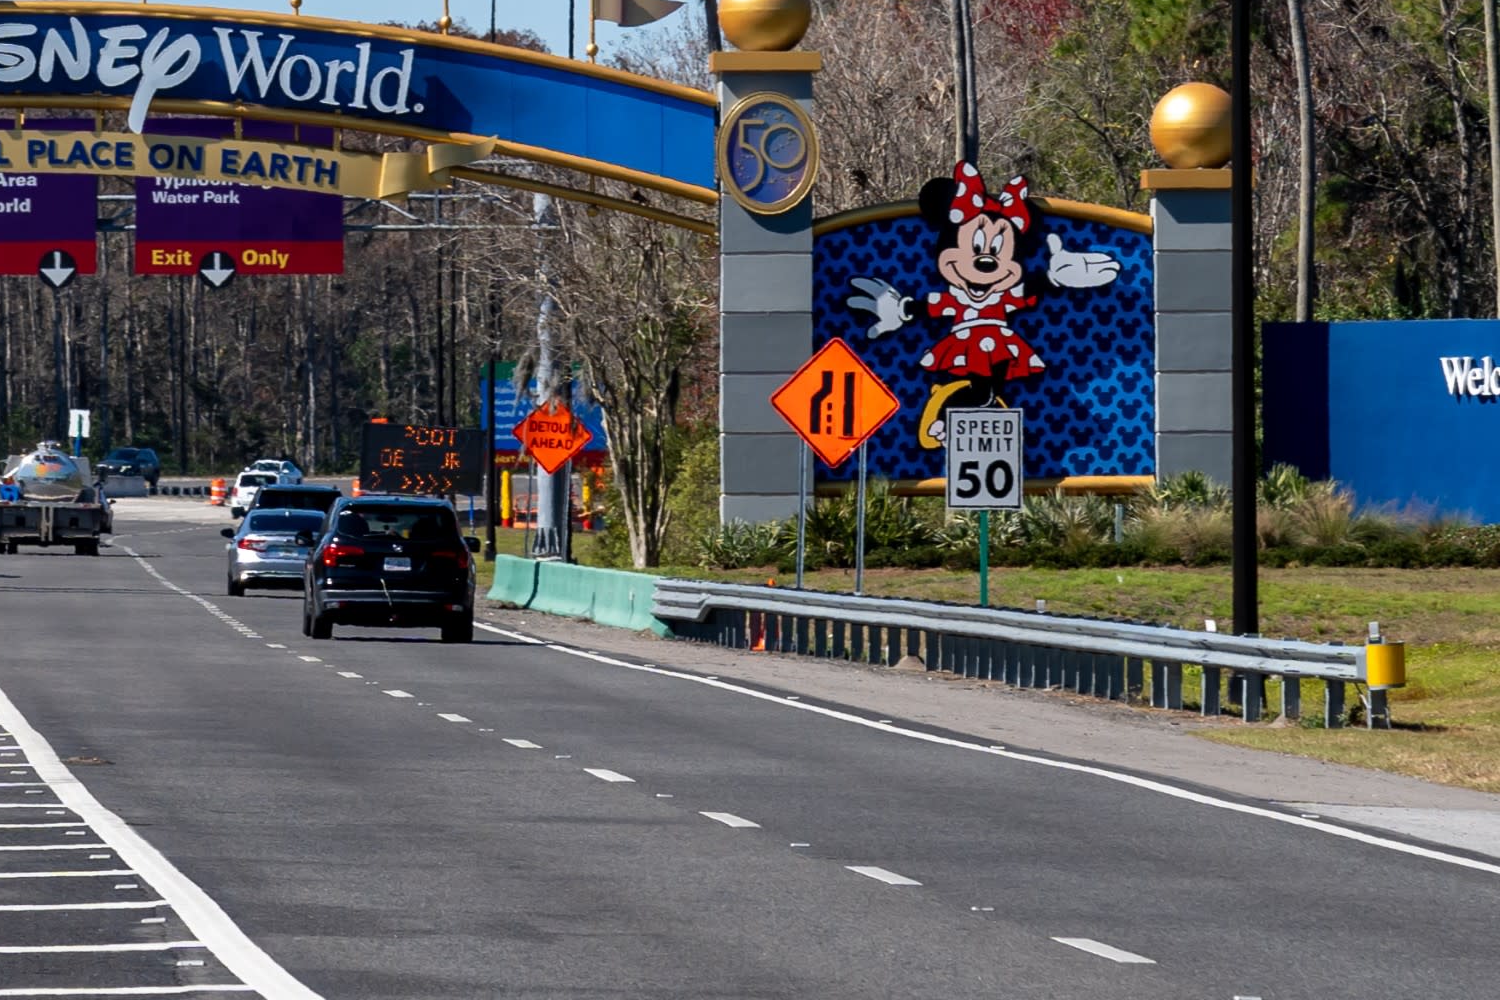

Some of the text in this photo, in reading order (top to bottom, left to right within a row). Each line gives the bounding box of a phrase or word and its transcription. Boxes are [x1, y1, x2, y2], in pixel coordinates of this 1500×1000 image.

[27, 139, 133, 168] PLACE
[148, 143, 205, 172] ON
[220, 148, 339, 186] EARTH
[738, 119, 806, 193] 50
[152, 190, 240, 204] Water Park
[151, 249, 289, 269] Exit Only
[528, 420, 577, 434] DETOU
[956, 419, 1014, 435] SPEED
[530, 437, 574, 451] AHEAD
[956, 437, 1013, 453] LIMIT
[955, 459, 1015, 499] 50
